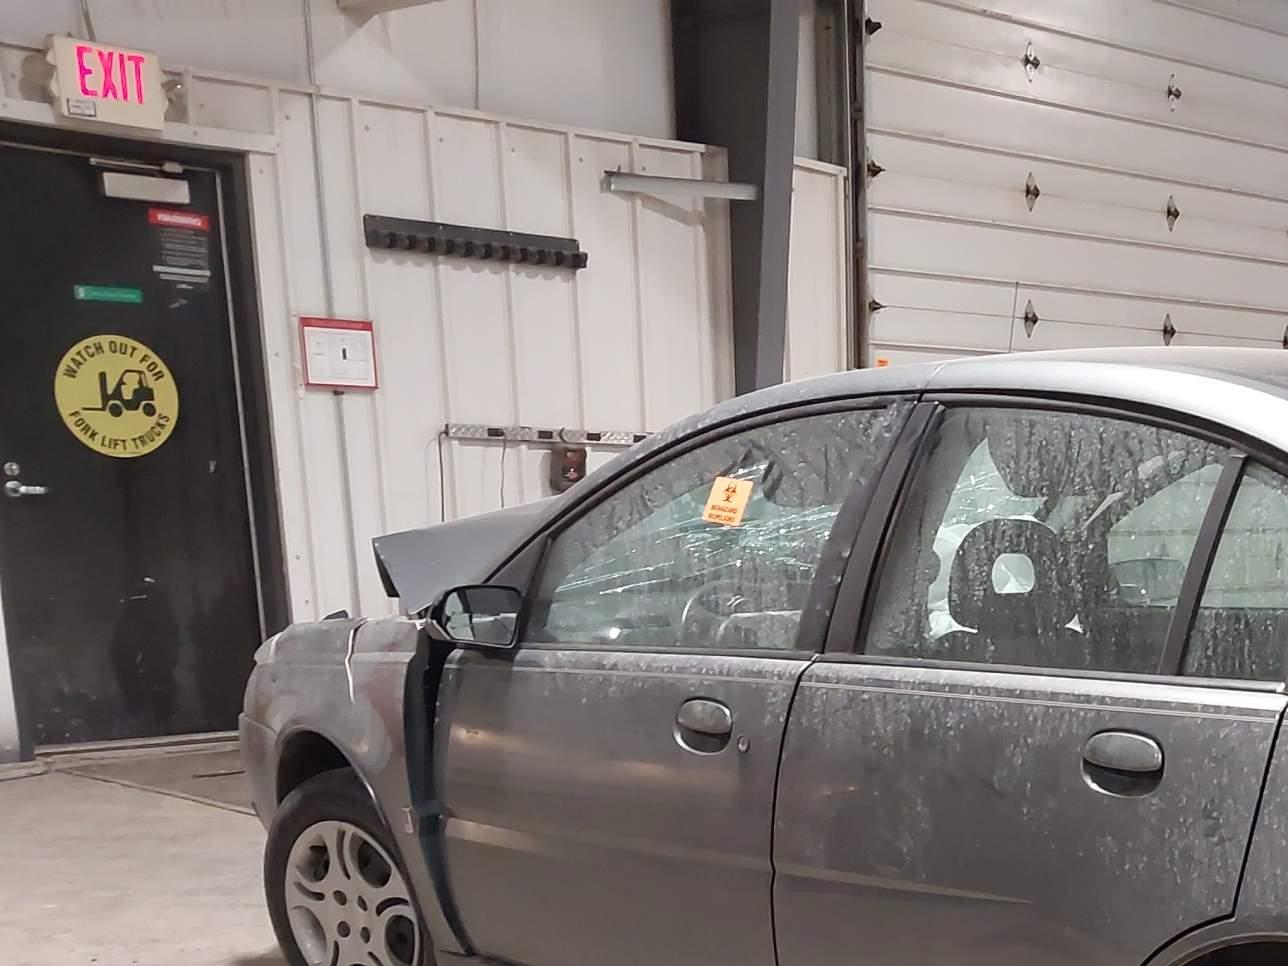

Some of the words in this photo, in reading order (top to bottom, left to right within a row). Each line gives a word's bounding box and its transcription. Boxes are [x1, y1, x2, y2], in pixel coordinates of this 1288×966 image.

[75, 45, 145, 105] EXIT
[63, 341, 104, 379] WATCH
[109, 340, 138, 358] OUT
[139, 354, 165, 382] FOR
[69, 410, 99, 441] FORK
[100, 435, 128, 451] LIFT
[130, 413, 171, 450] TRUCKS
